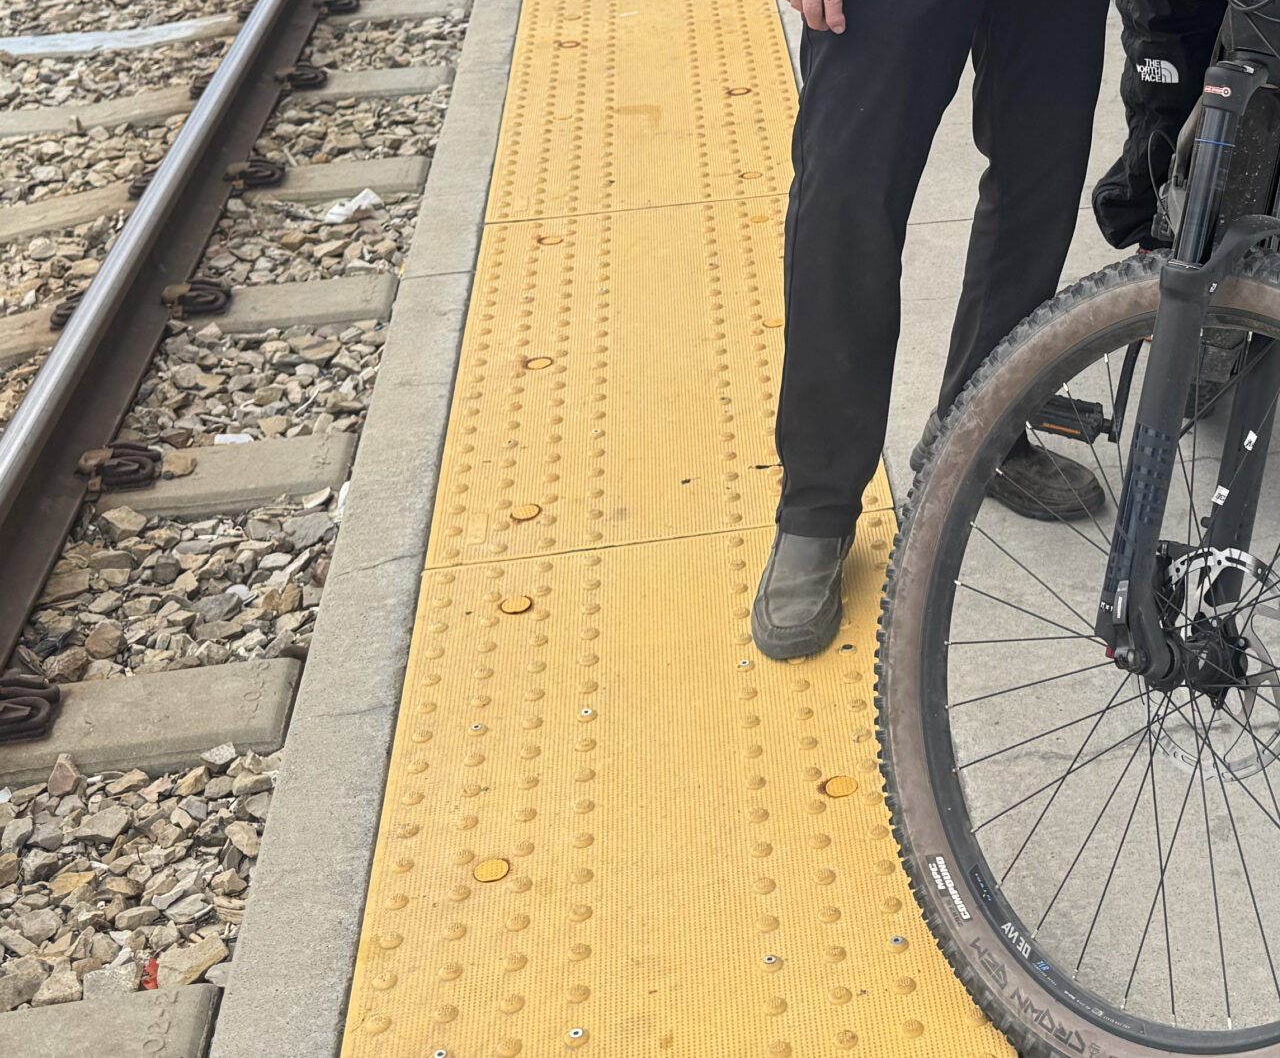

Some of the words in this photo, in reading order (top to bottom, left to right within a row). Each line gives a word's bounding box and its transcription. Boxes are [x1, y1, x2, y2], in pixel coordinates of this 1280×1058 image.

[1136, 63, 1161, 76] NORTH
[1144, 58, 1160, 68] THE
[1141, 73, 1162, 83] FACE
[928, 862, 946, 890] MPC
[935, 855, 971, 920] COMPOUND
[970, 937, 1009, 990] GEM
[1010, 988, 1087, 1055] CROWN
